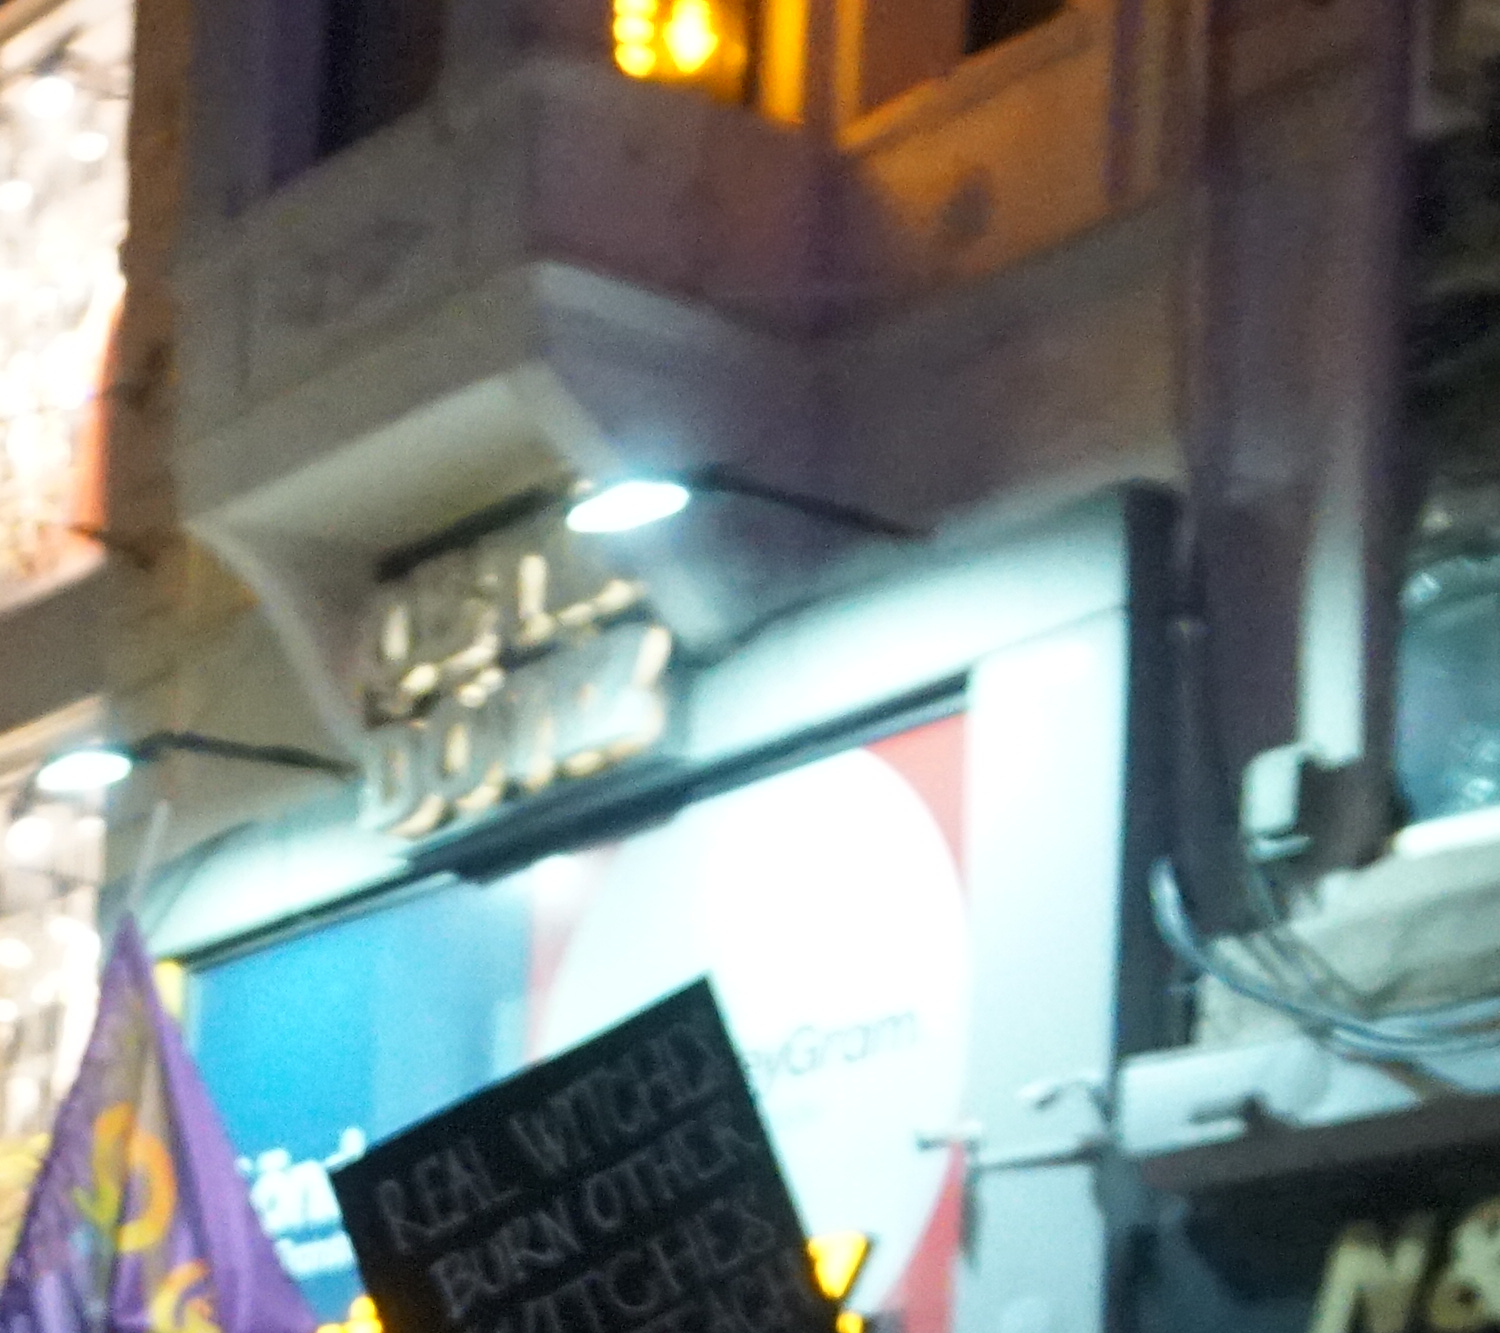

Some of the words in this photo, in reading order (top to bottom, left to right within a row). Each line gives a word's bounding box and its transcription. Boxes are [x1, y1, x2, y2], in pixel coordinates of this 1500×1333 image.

[374, 1139, 516, 1252] REAL
[430, 1201, 579, 1320] BURN
[584, 1097, 760, 1229] OTHER
